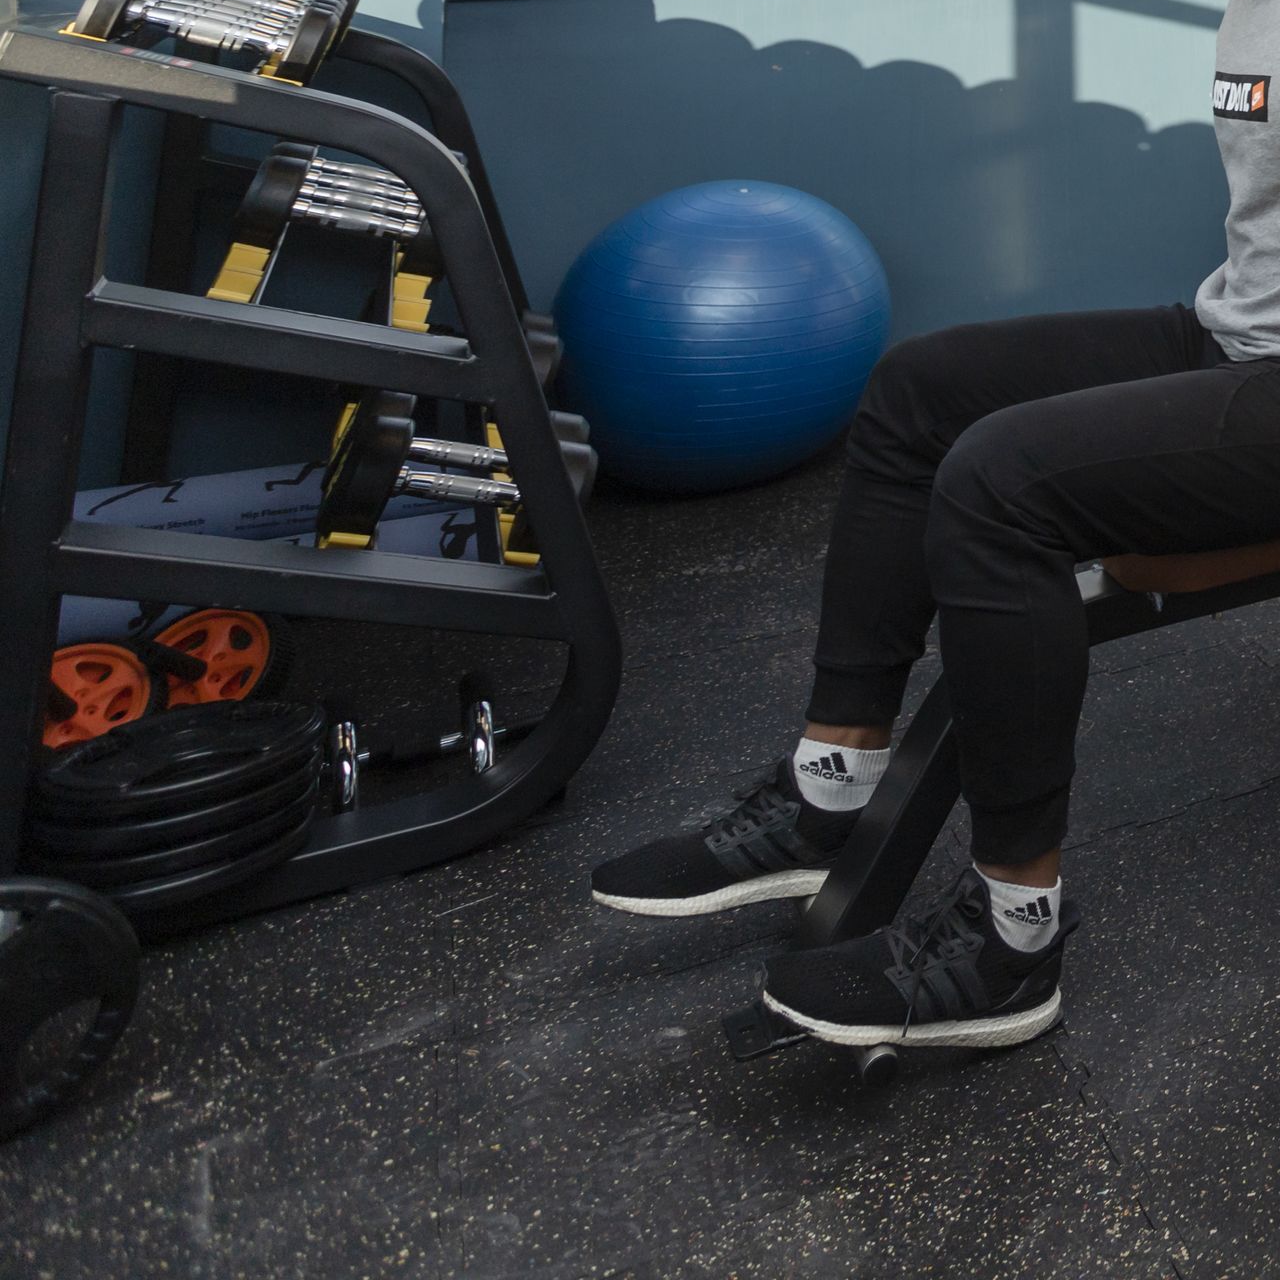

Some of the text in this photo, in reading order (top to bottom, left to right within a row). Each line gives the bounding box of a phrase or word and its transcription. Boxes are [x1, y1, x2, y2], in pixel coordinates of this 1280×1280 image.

[1213, 80, 1231, 110] UST
[800, 764, 854, 783] adidas
[1004, 909, 1053, 926] adida
